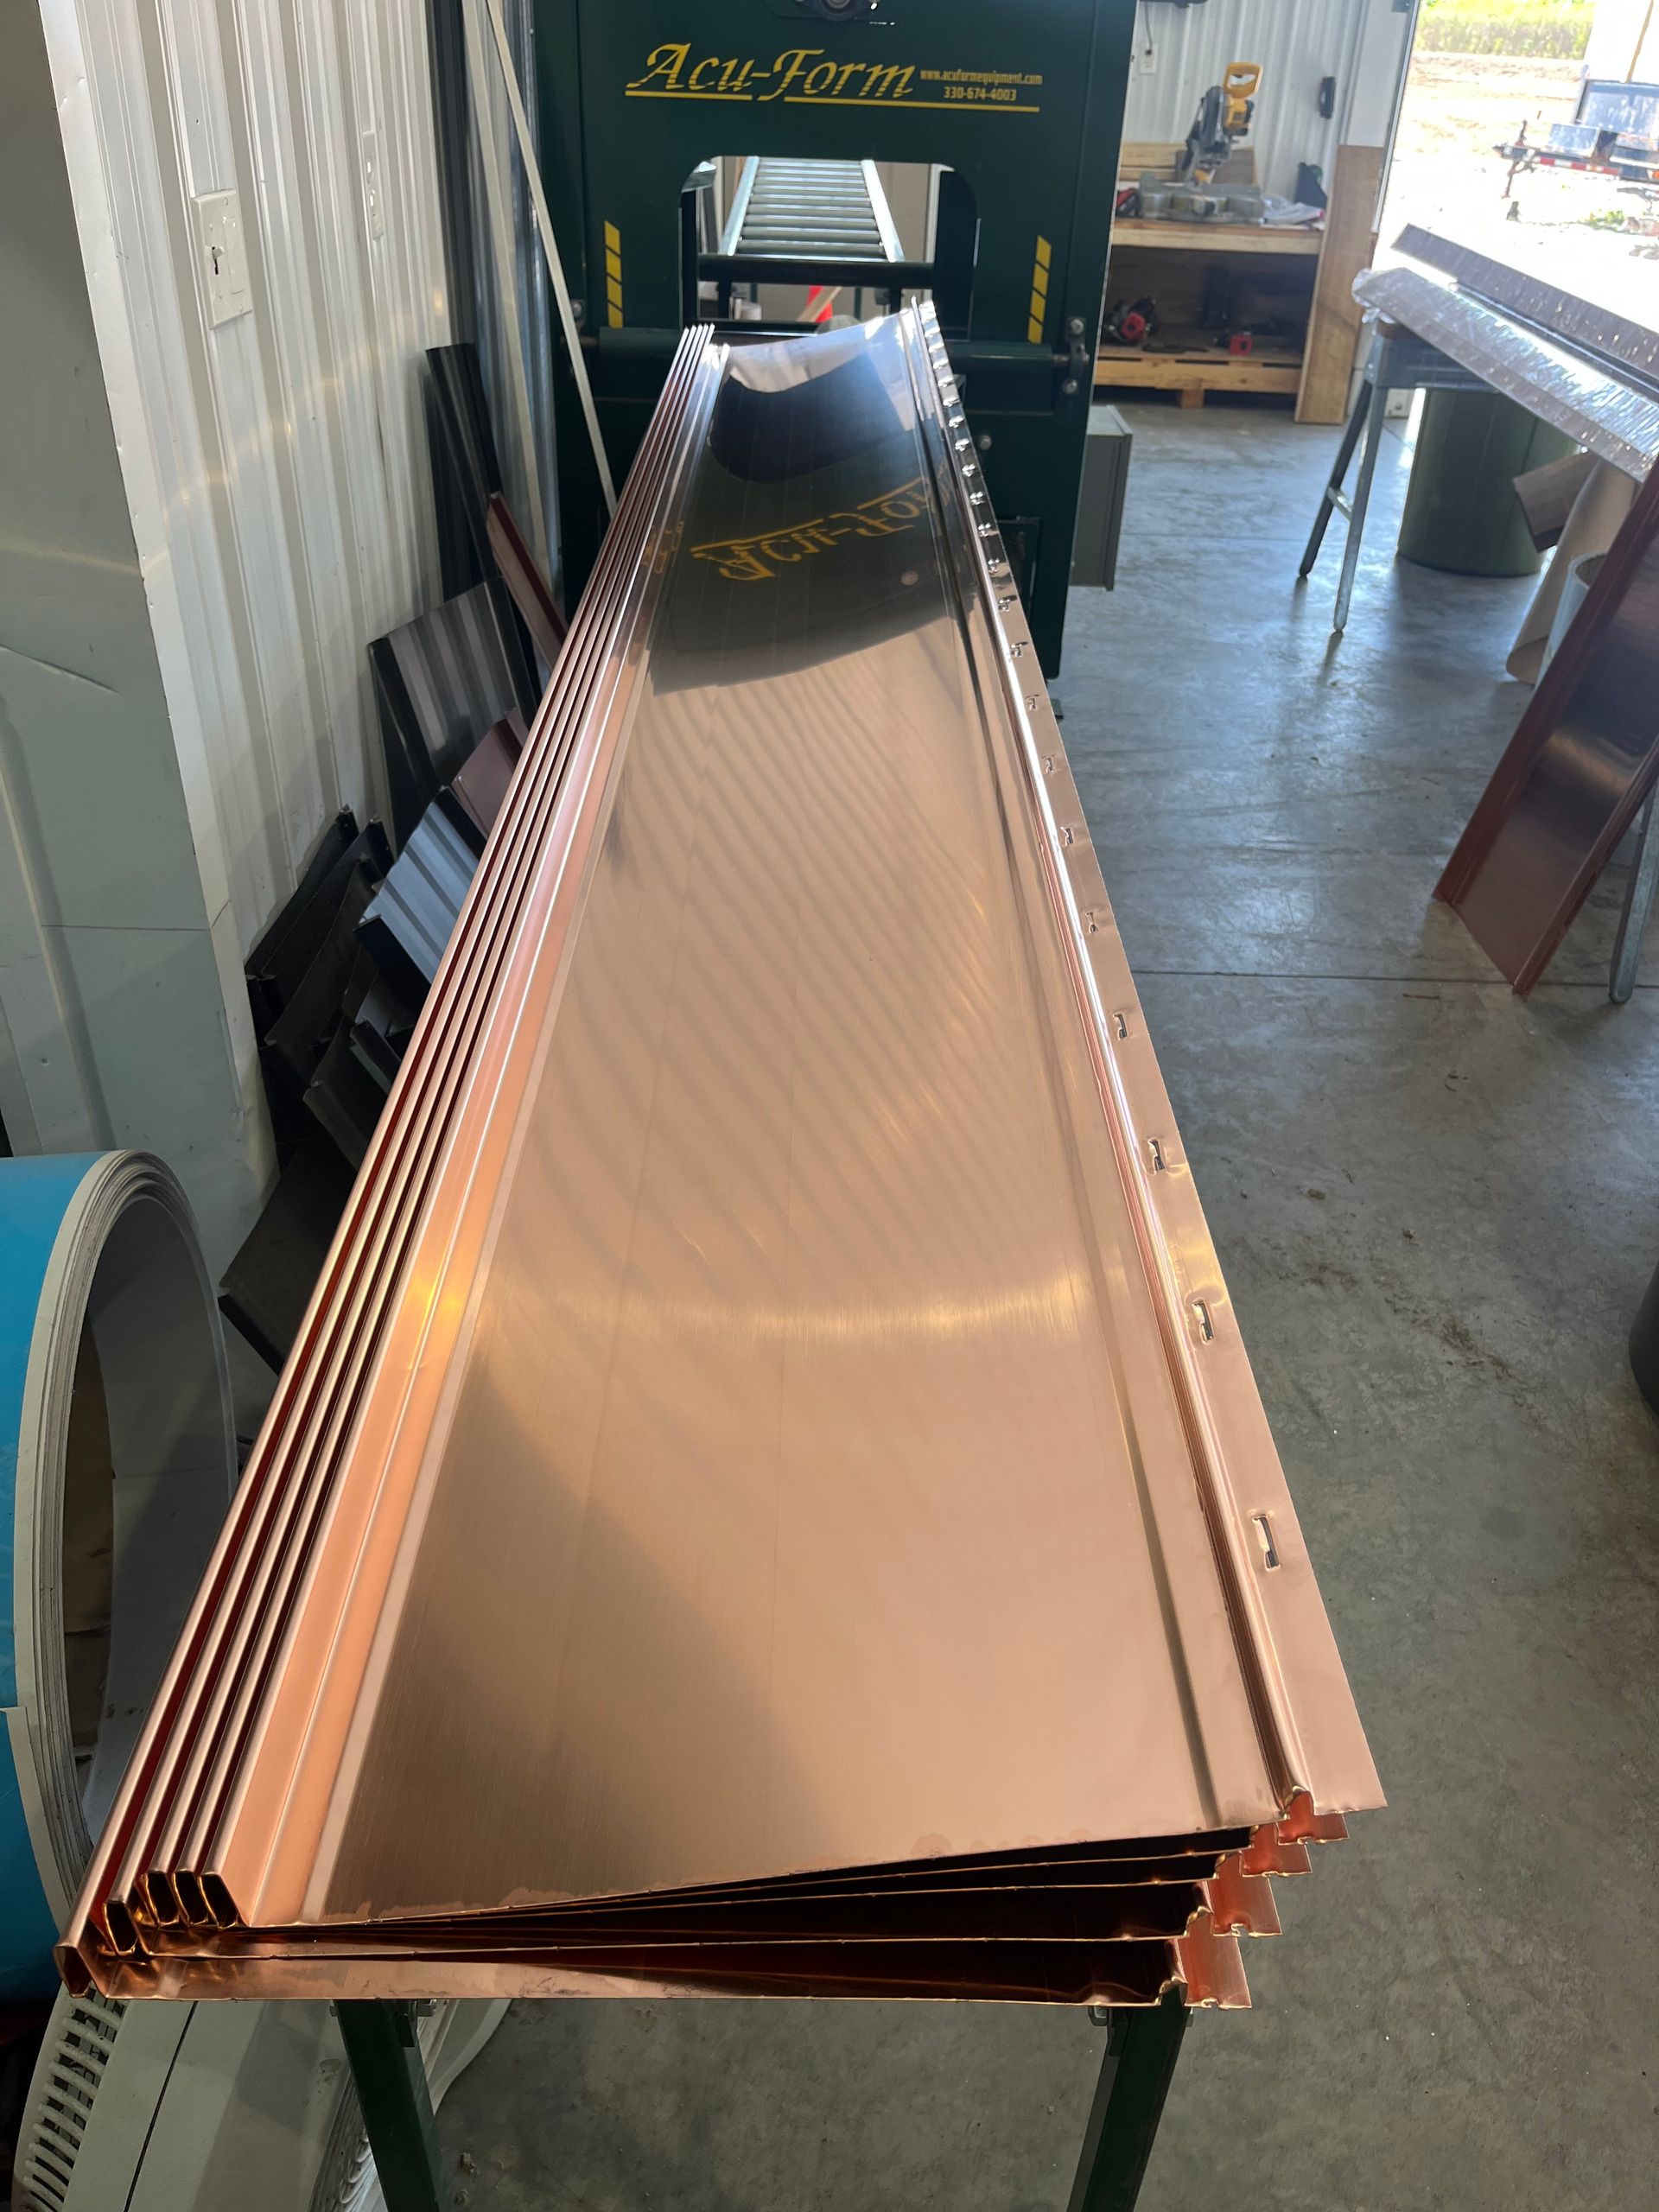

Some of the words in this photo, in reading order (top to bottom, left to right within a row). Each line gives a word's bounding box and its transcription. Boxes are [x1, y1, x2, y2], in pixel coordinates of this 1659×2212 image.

[626, 42, 916, 100] Acu-Form
[919, 68, 1044, 86] www.acuformequipment.com
[943, 86, 1018, 102] 330-674-4003
